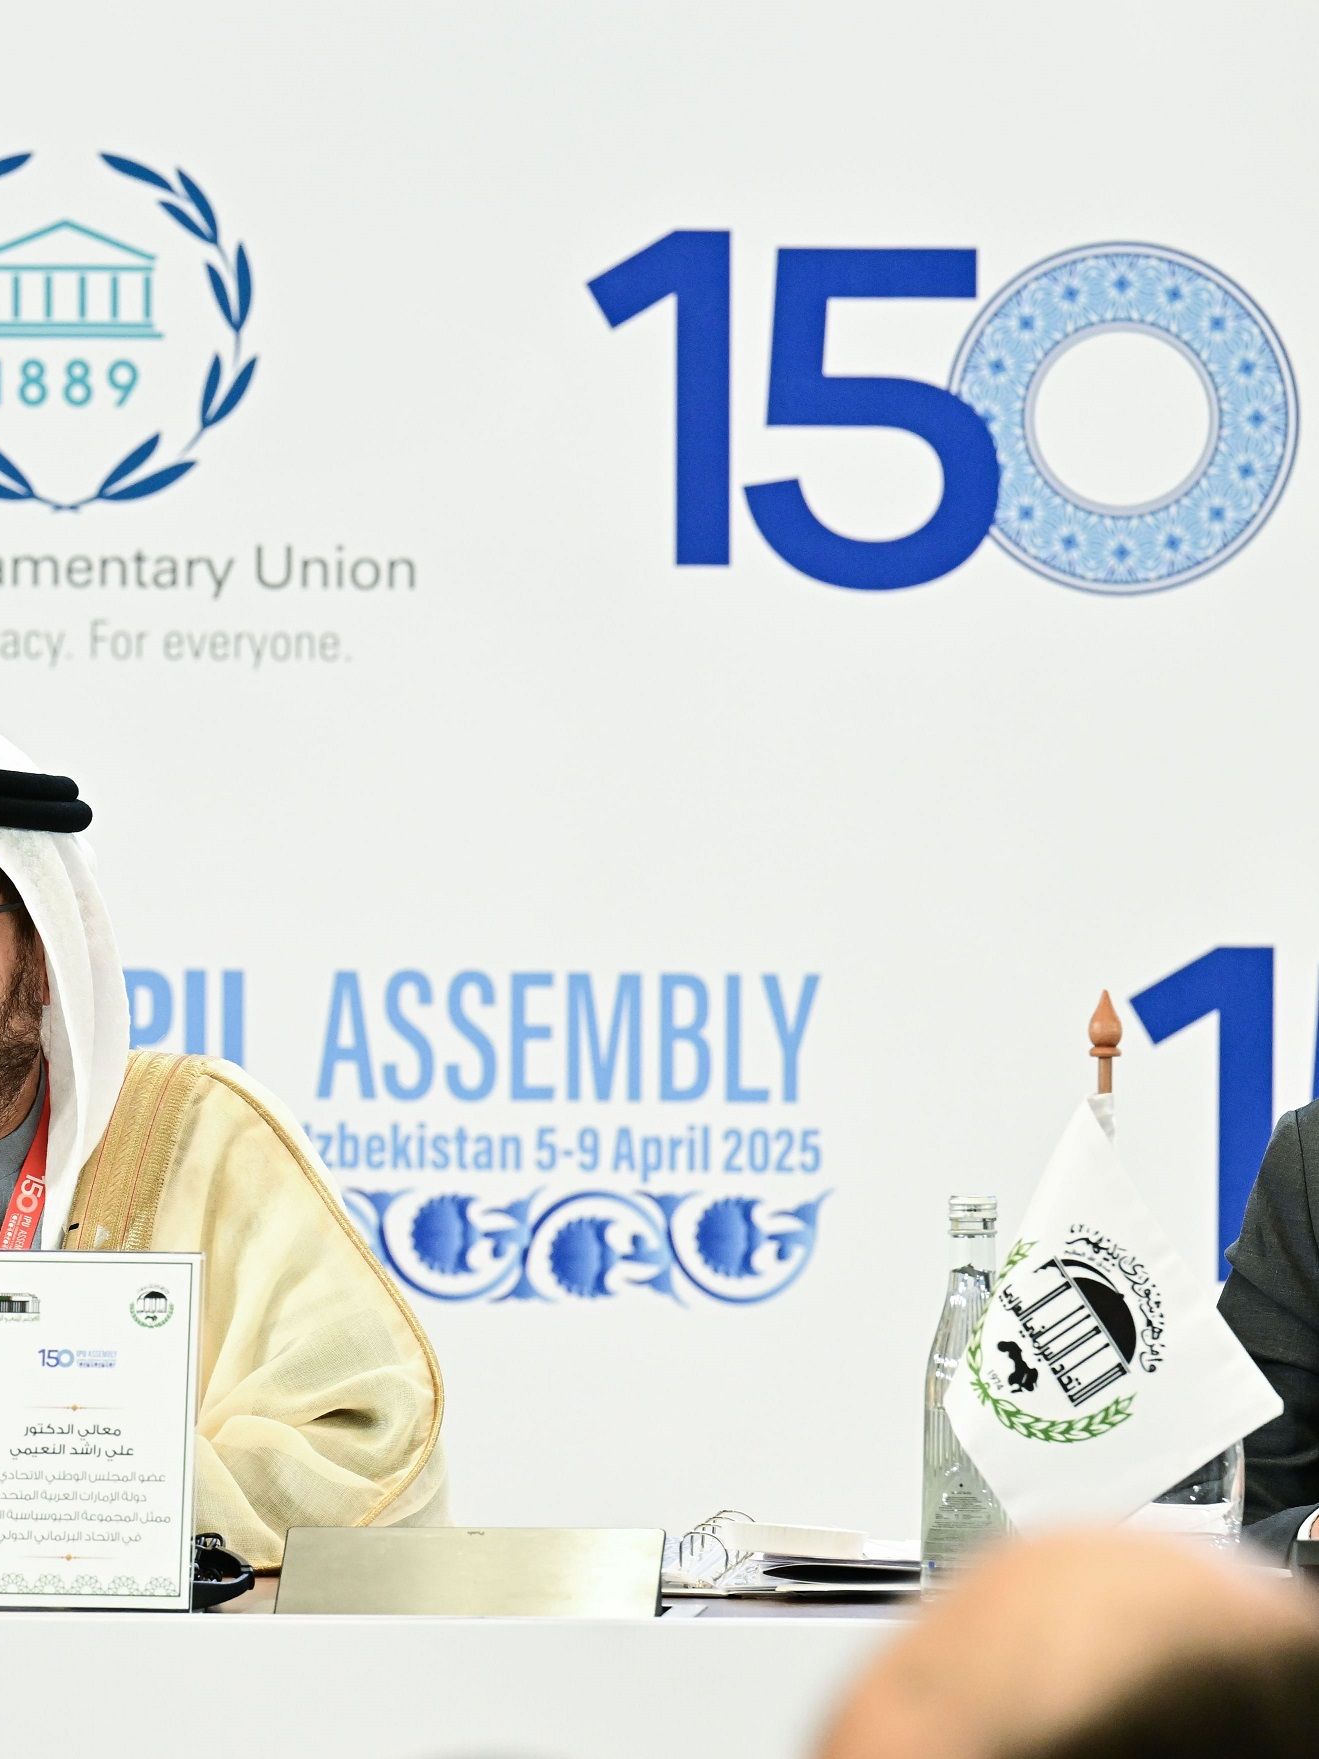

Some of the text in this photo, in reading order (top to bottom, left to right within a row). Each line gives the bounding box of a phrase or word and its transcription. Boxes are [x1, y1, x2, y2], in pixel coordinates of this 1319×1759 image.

[586, 229, 1300, 596] 150
[255, 544, 416, 591] Union
[89, 618, 149, 662] For
[162, 629, 352, 671] everyone.
[122, 968, 821, 1104] PU ASSEMBLY
[306, 1123, 822, 1186] zbekistan 5-9 April 2025
[16, 1174, 46, 1214] 150
[38, 1348, 75, 1368] 150
[10, 1442, 134, 1461] علي راشد النعيمي
[24, 1423, 121, 1441] معالي الدكتور
